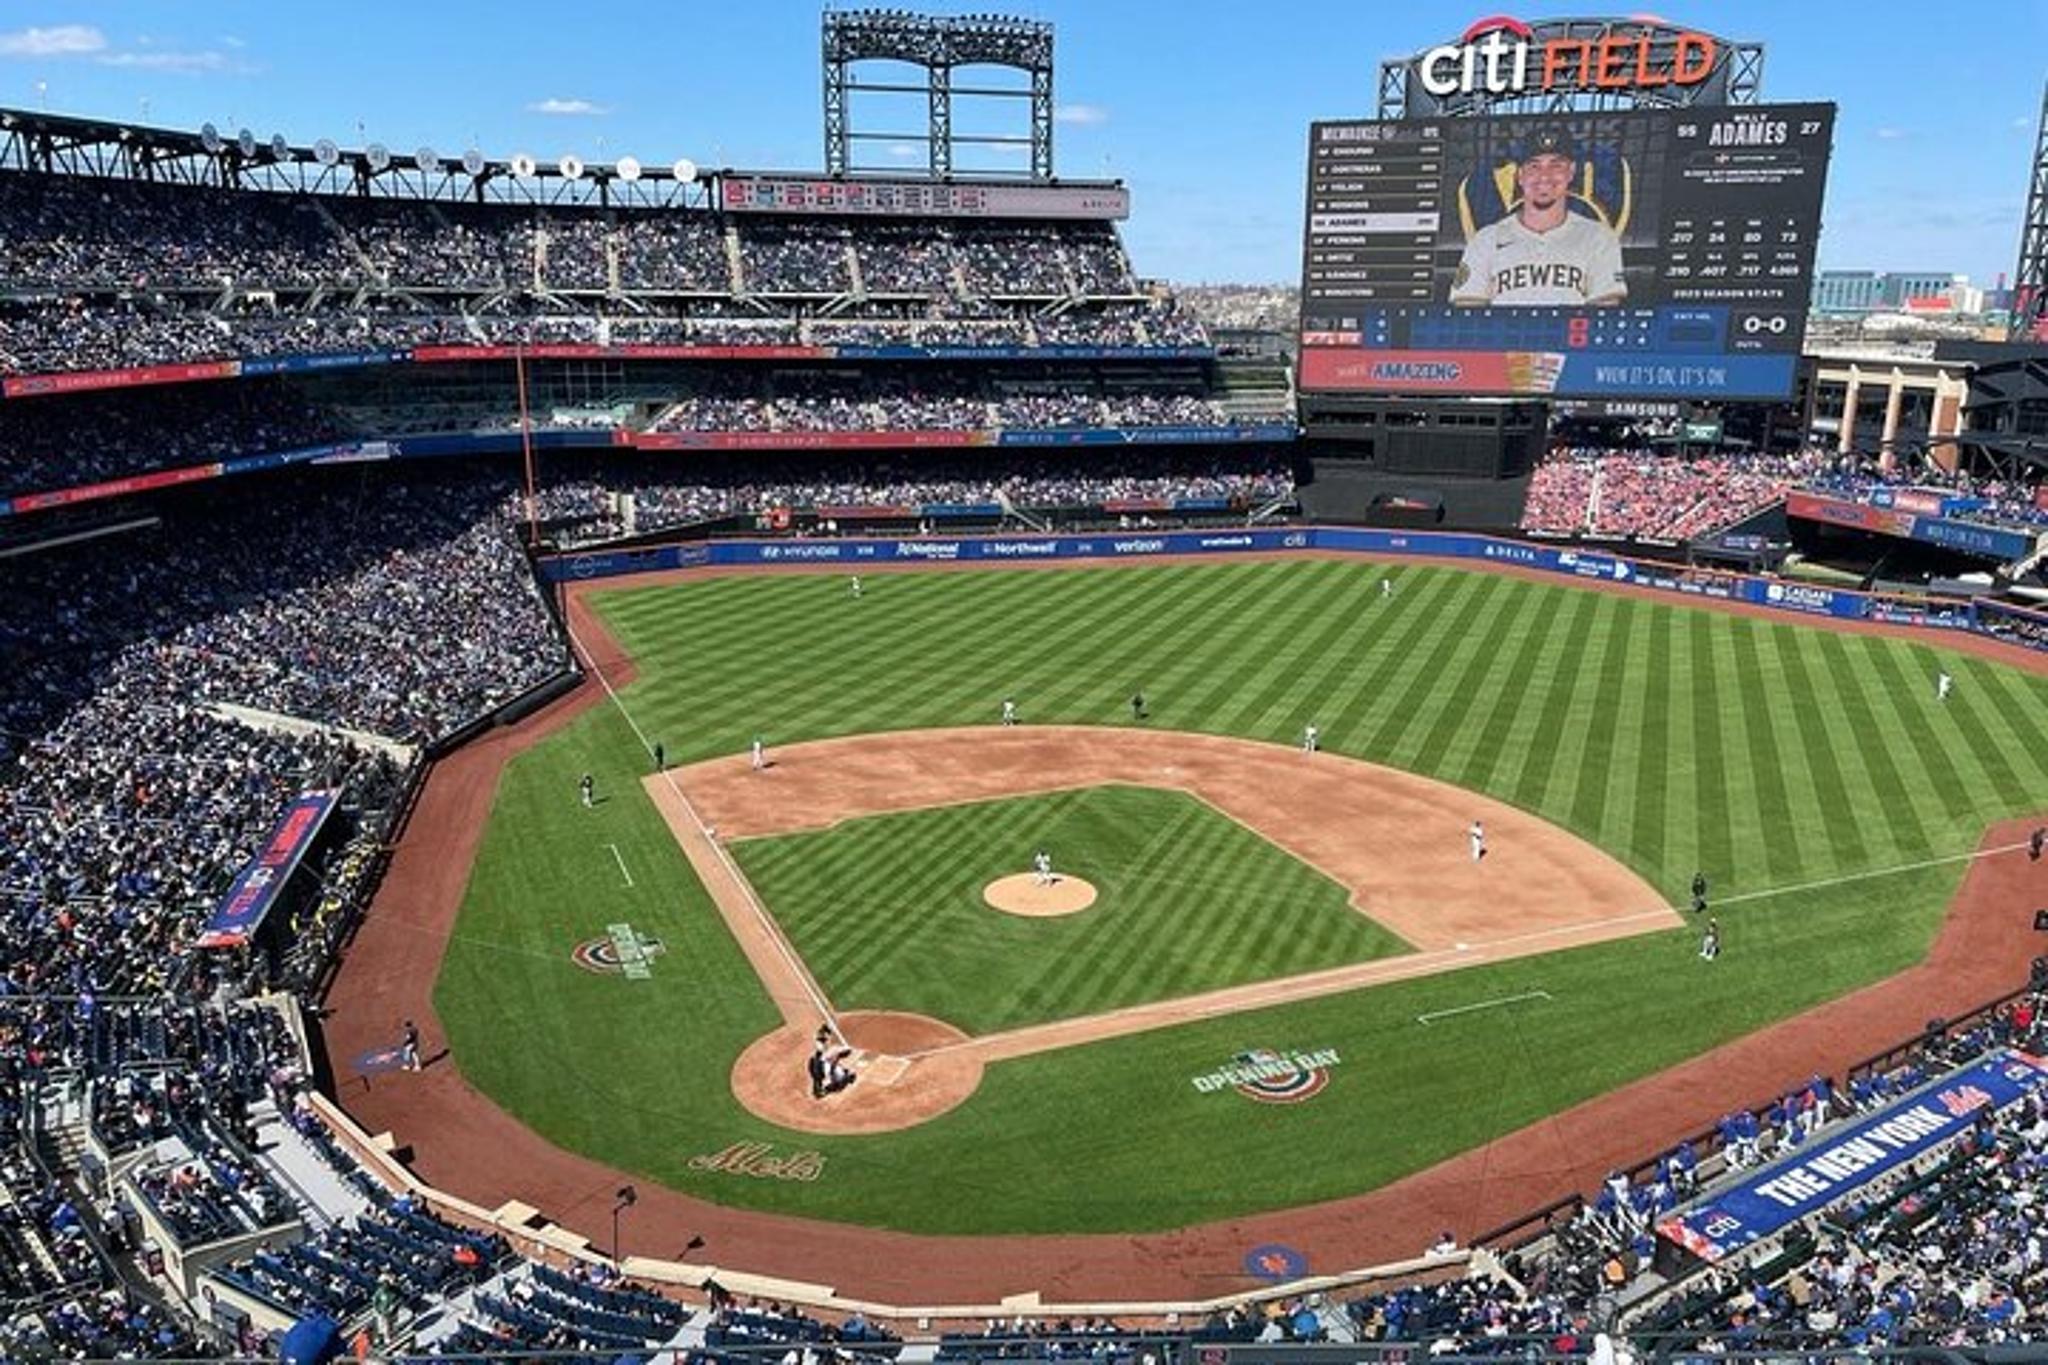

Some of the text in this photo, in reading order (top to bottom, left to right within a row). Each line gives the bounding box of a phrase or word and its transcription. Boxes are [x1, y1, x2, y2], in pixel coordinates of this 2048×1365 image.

[1421, 31, 1717, 94] citi FIELD
[1709, 121, 1788, 146] ADAMES
[1801, 121, 1822, 135] 27
[1708, 232, 1726, 243] 24
[1743, 232, 1763, 243] 80
[1703, 289, 1745, 298] SEASON
[1370, 362, 1463, 381] AMAZING
[1605, 403, 1679, 416] SAMSUNG
[994, 542, 1058, 555] Northwell
[1114, 540, 1164, 552] verizon
[1498, 546, 1535, 561] DELTA
[1192, 1049, 1342, 1093] OPENING DAY
[687, 1140, 829, 1182] Mets
[1755, 1167, 1834, 1207] THE
[1807, 1137, 1888, 1182] NEW
[1865, 1105, 1952, 1149] YORK
[1705, 1217, 1742, 1237] citi
